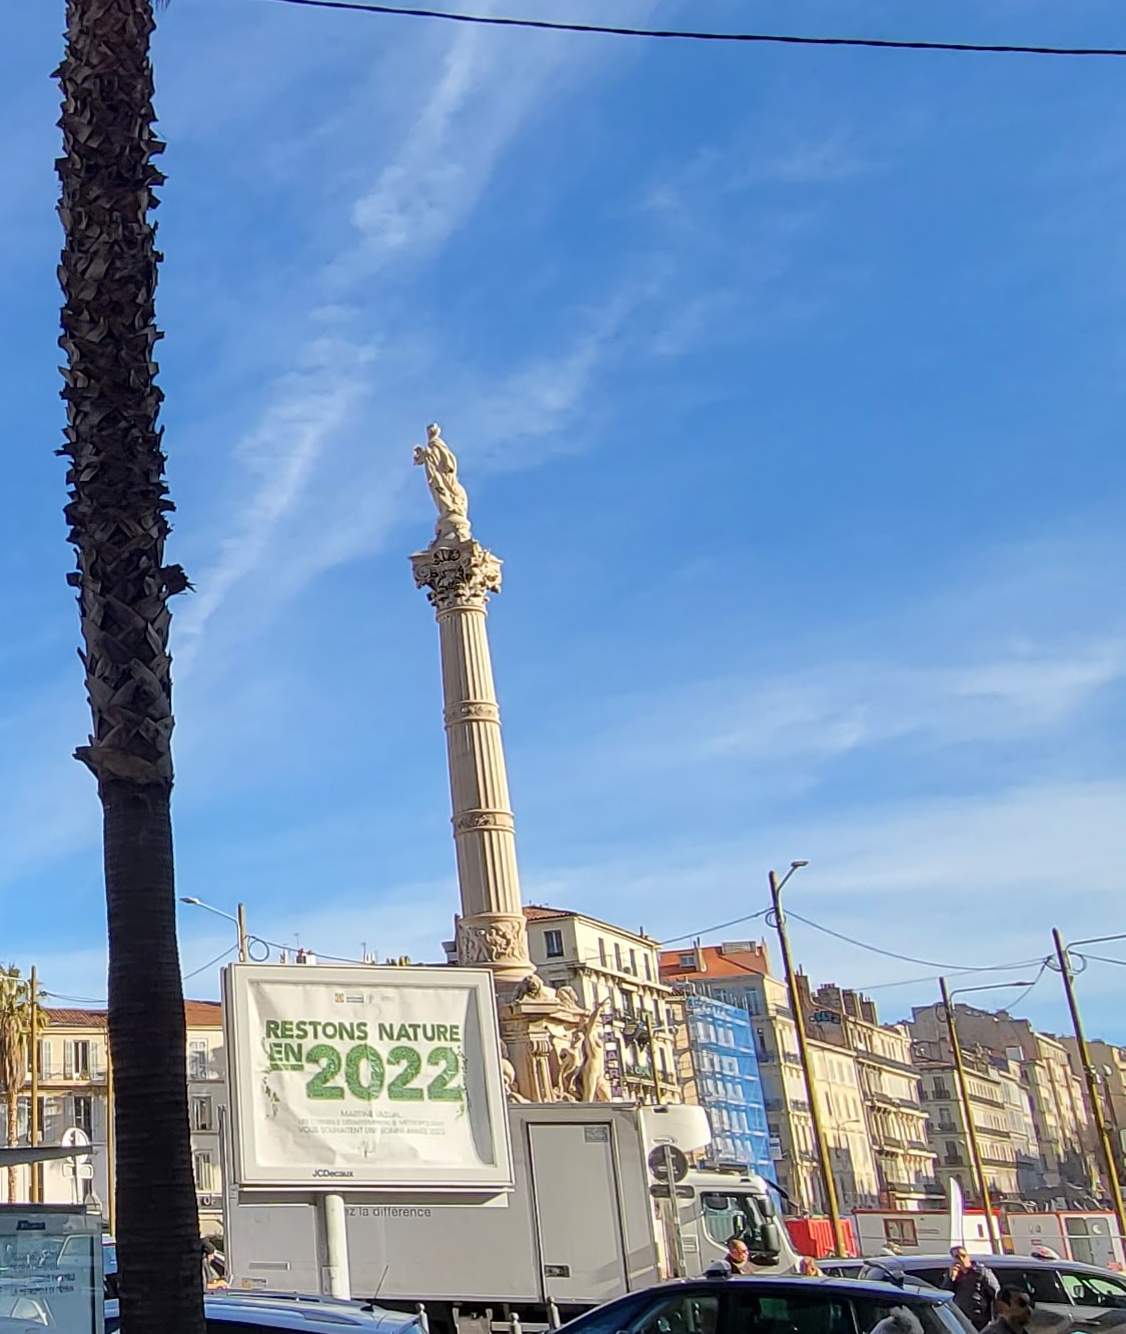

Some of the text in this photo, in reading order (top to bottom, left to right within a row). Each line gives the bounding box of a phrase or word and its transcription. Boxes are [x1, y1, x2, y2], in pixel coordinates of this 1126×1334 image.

[265, 1019, 462, 1043] RESTONS NATURE
[269, 1042, 464, 1102] EN 2022
[312, 1169, 354, 1178] JCDecaux
[358, 1207, 370, 1217] la
